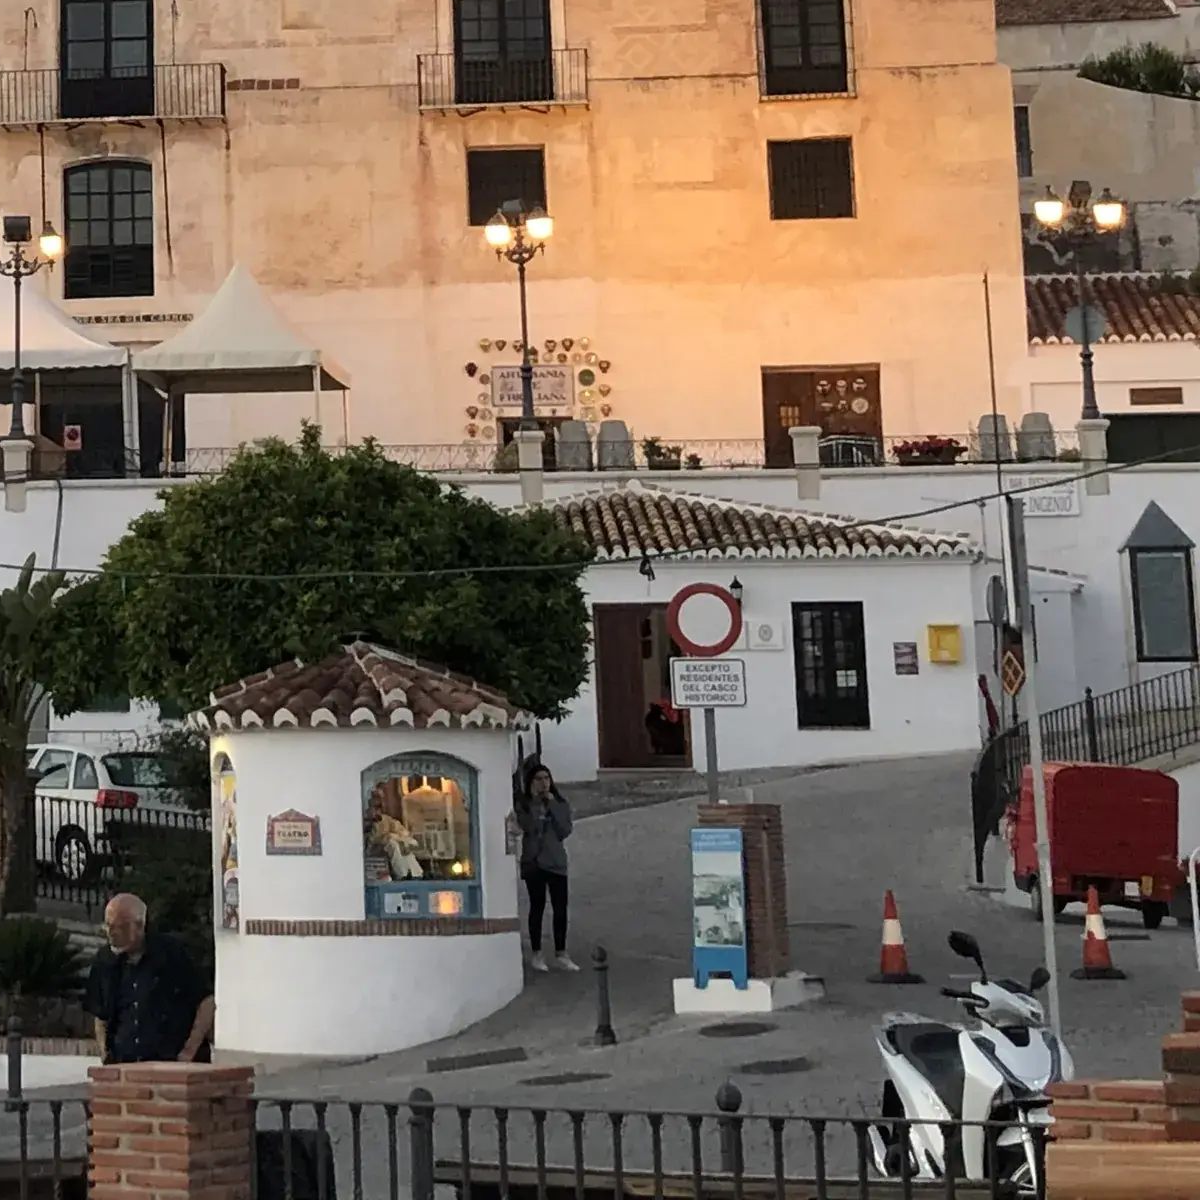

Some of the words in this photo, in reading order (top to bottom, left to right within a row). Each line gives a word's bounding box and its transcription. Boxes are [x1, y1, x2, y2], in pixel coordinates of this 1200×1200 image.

[685, 664, 730, 672] EXCEPTO
[680, 674, 740, 682] RESIDENTES
[682, 684, 700, 692] DEL
[704, 684, 738, 692] CASCO
